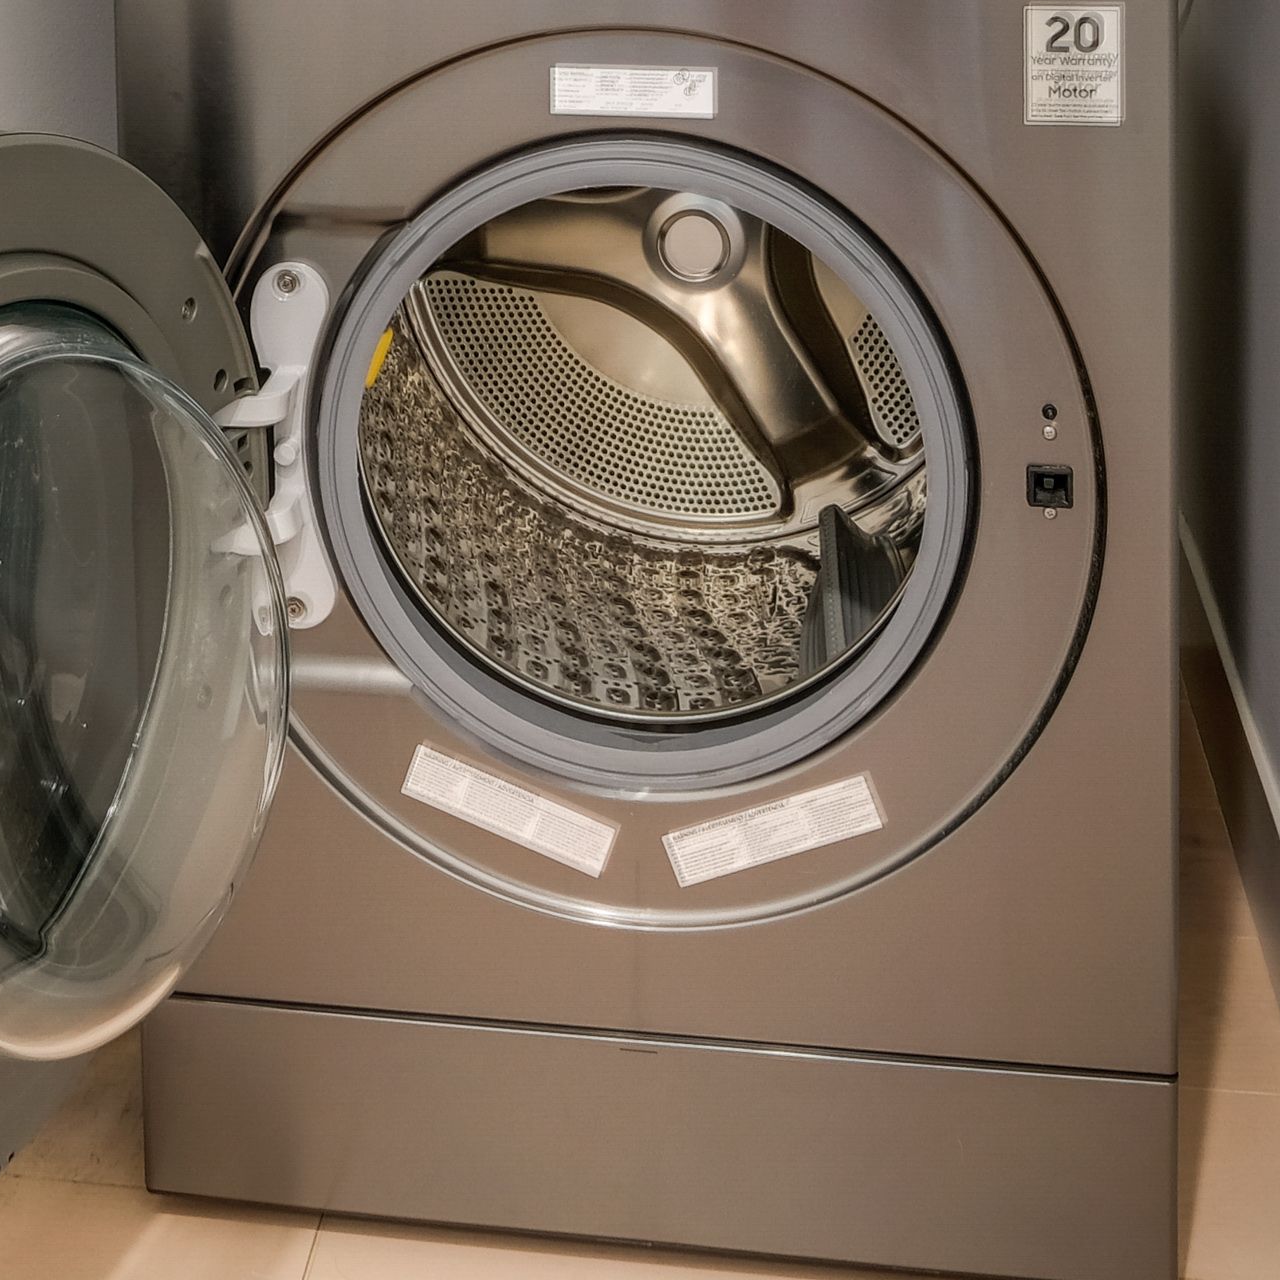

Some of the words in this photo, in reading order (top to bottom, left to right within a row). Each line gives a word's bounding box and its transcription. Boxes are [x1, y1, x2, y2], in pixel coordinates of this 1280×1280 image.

[1045, 16, 1100, 53] 20
[1030, 55, 1057, 66] Year
[1059, 56, 1113, 68] Warranty
[1045, 72, 1074, 83] Digital
[1048, 85, 1096, 99] Motor
